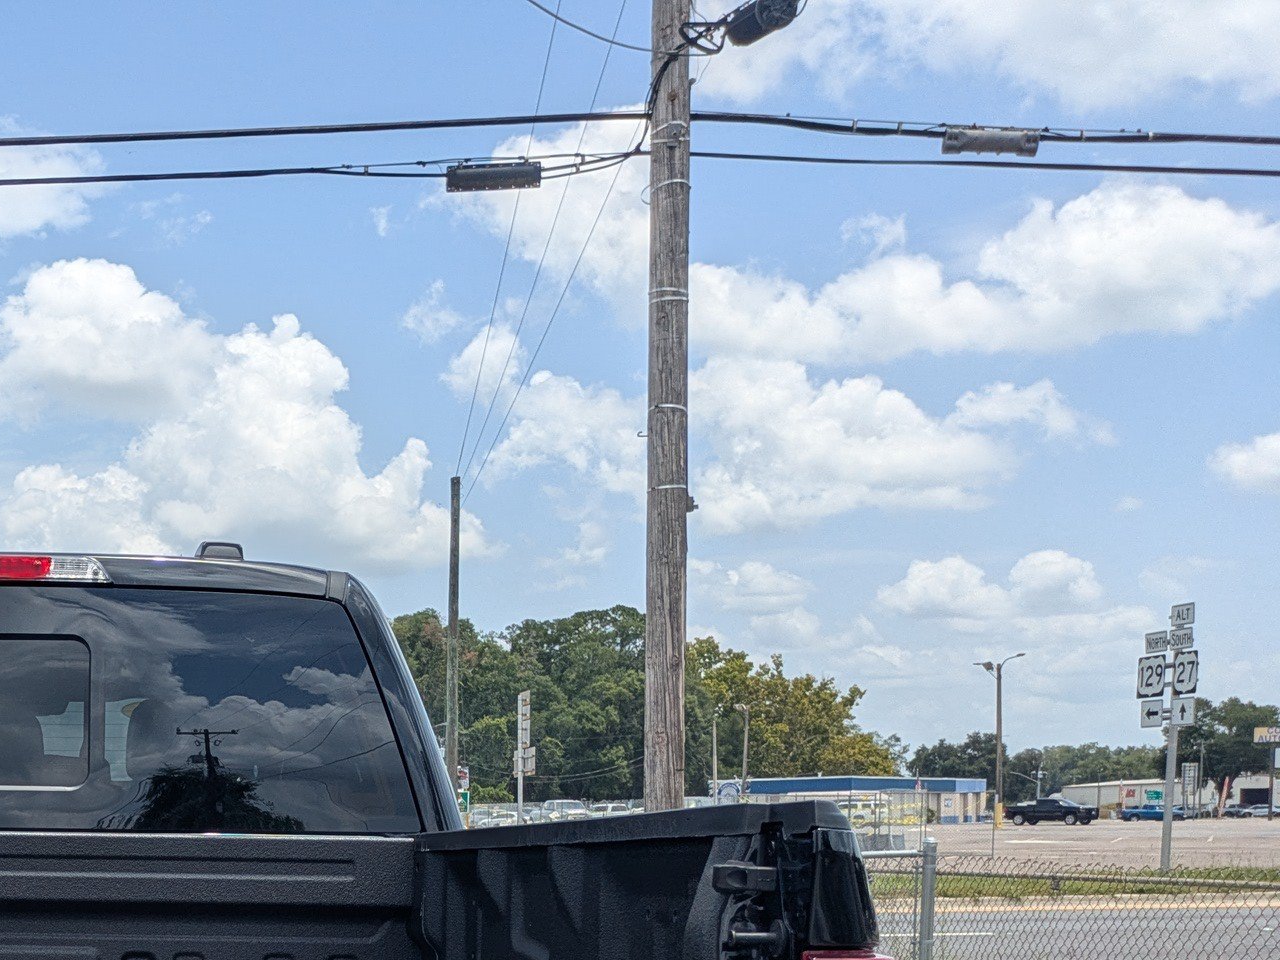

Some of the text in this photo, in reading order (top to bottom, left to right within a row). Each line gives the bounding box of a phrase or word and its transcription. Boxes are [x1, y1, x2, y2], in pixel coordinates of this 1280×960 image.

[1175, 608, 1190, 621] ALT
[1146, 636, 1166, 650] NORTH
[1171, 632, 1192, 647] SOUTH
[1140, 664, 1163, 688] 129
[1176, 660, 1195, 684] 27
